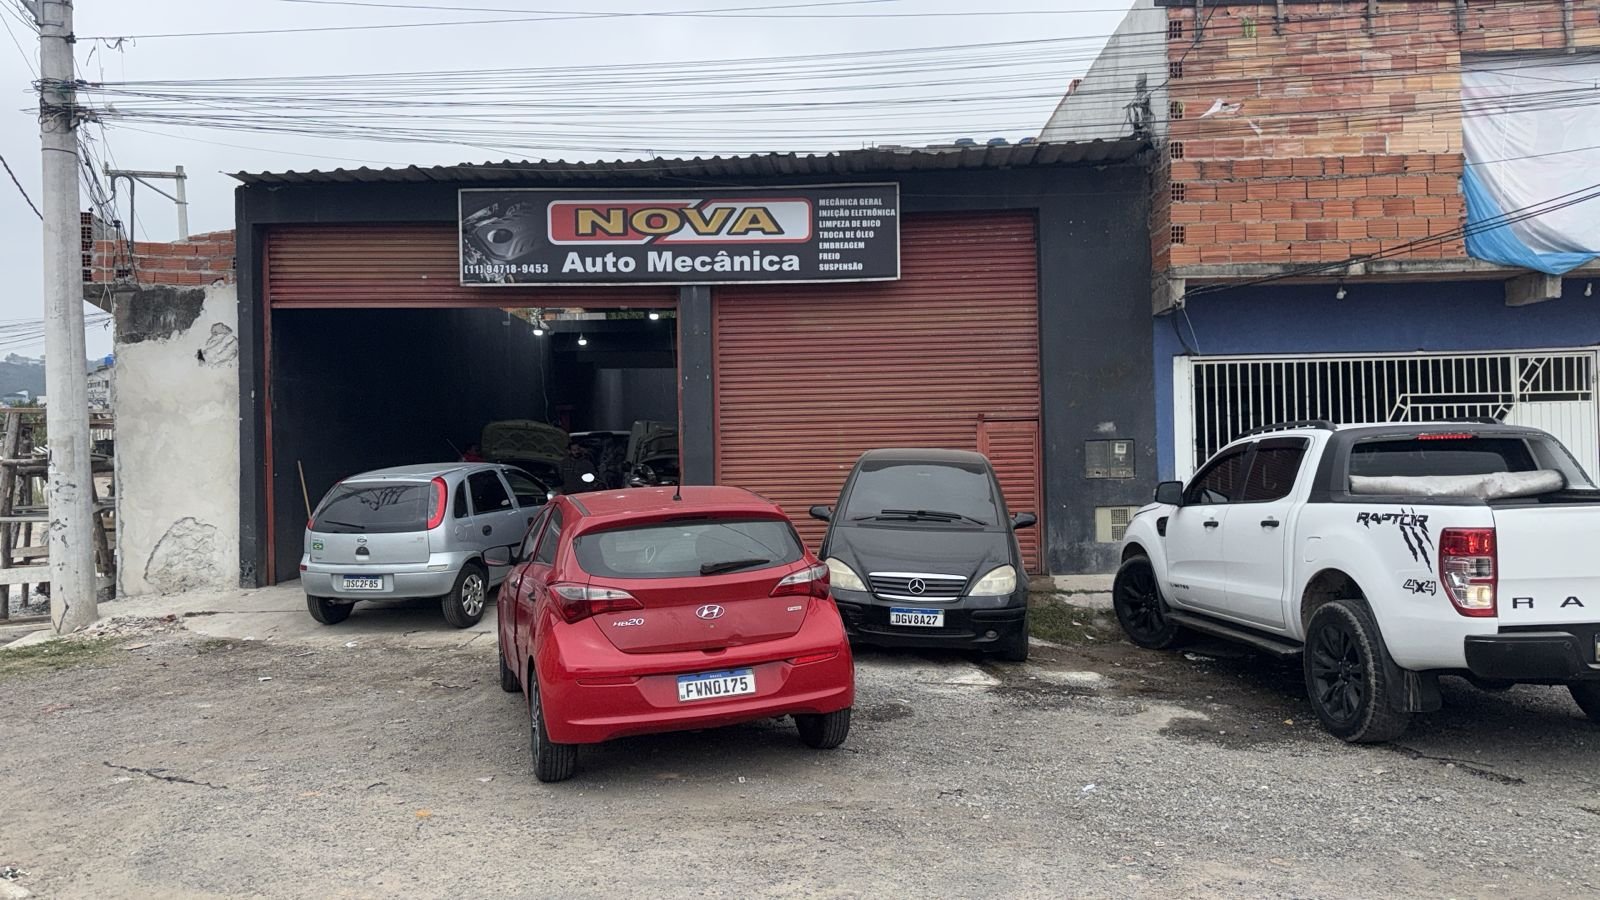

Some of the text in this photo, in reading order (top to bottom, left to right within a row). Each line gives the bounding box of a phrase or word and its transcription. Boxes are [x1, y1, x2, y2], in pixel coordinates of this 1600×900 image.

[819, 198, 883, 206] MECÂNICA GERAL
[819, 208, 896, 218] INJEÇÃO ELETRÔNICA
[576, 207, 784, 236] NOVA
[819, 219, 881, 228] LIMPEZA DE BICO
[819, 231, 844, 239] TROCA
[856, 230, 875, 238] ÓLEO
[819, 241, 865, 250] EMBREAGEM
[819, 252, 840, 260] FREIO
[561, 250, 801, 273] Auto Mecânica
[464, 264, 549, 274] (11) 94718-9453
[819, 262, 863, 271] SUSPENSÃO
[1356, 511, 1429, 533] RAPTOR
[346, 579, 379, 588] DSC2F85
[612, 617, 645, 627] HB20
[895, 613, 938, 625] DGV8A27
